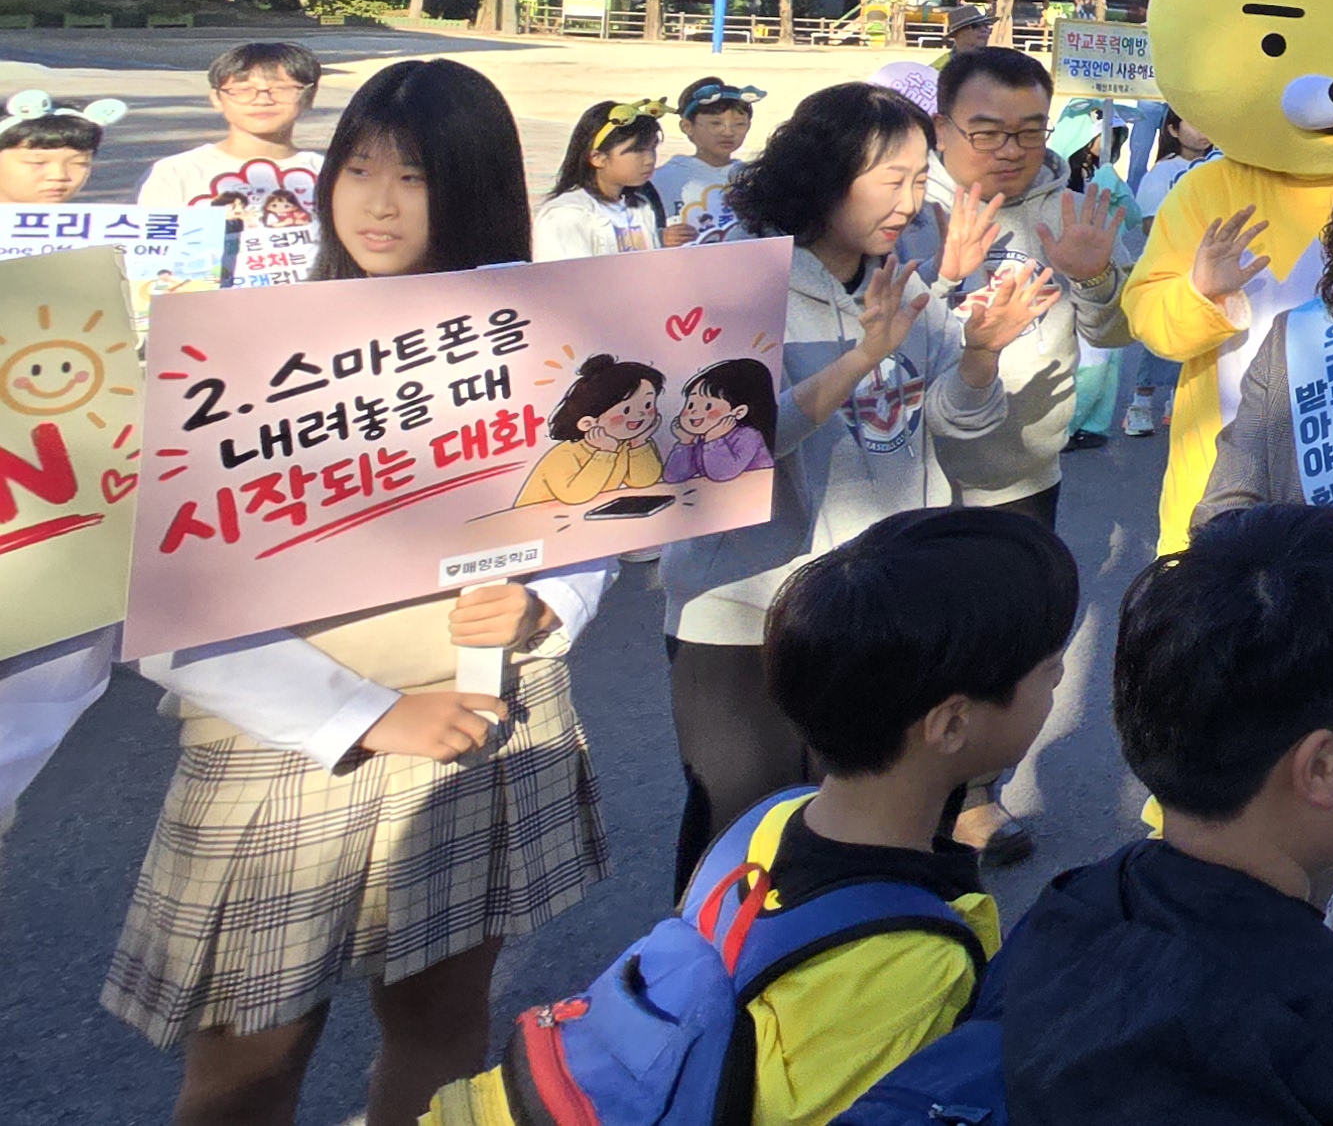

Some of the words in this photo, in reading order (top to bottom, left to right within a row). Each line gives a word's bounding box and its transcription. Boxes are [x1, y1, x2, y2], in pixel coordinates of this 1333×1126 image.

[11, 212, 92, 239] 프리
[103, 212, 180, 241] 스쿨
[134, 245, 169, 256] ON!
[246, 252, 307, 271] 상처는
[182, 377, 255, 432] 2.
[266, 307, 531, 403] 스마트폰을
[219, 380, 435, 469] 내려놓을
[447, 364, 512, 408] 때
[159, 447, 417, 555] 시작되는
[429, 403, 545, 469] 대화
